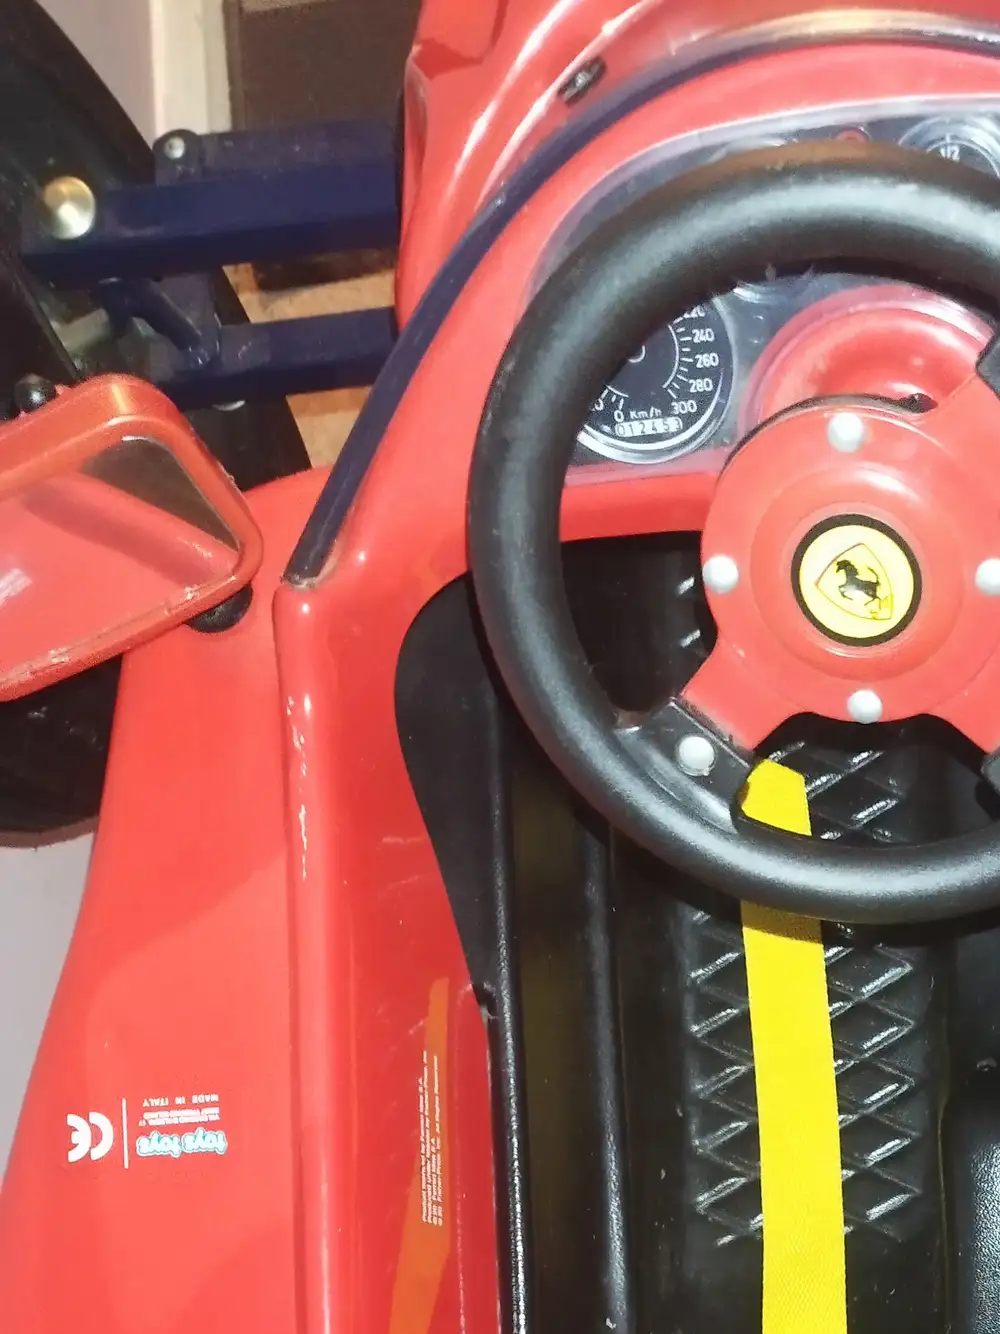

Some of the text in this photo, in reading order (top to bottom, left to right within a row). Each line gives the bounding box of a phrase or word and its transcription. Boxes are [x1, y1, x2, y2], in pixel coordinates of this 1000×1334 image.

[692, 328, 715, 343] 240
[695, 352, 719, 368] 260
[689, 378, 713, 393] 280
[671, 399, 697, 415] 300
[614, 410, 624, 422] 0
[142, 1094, 219, 1108] MADE IN ITALY
